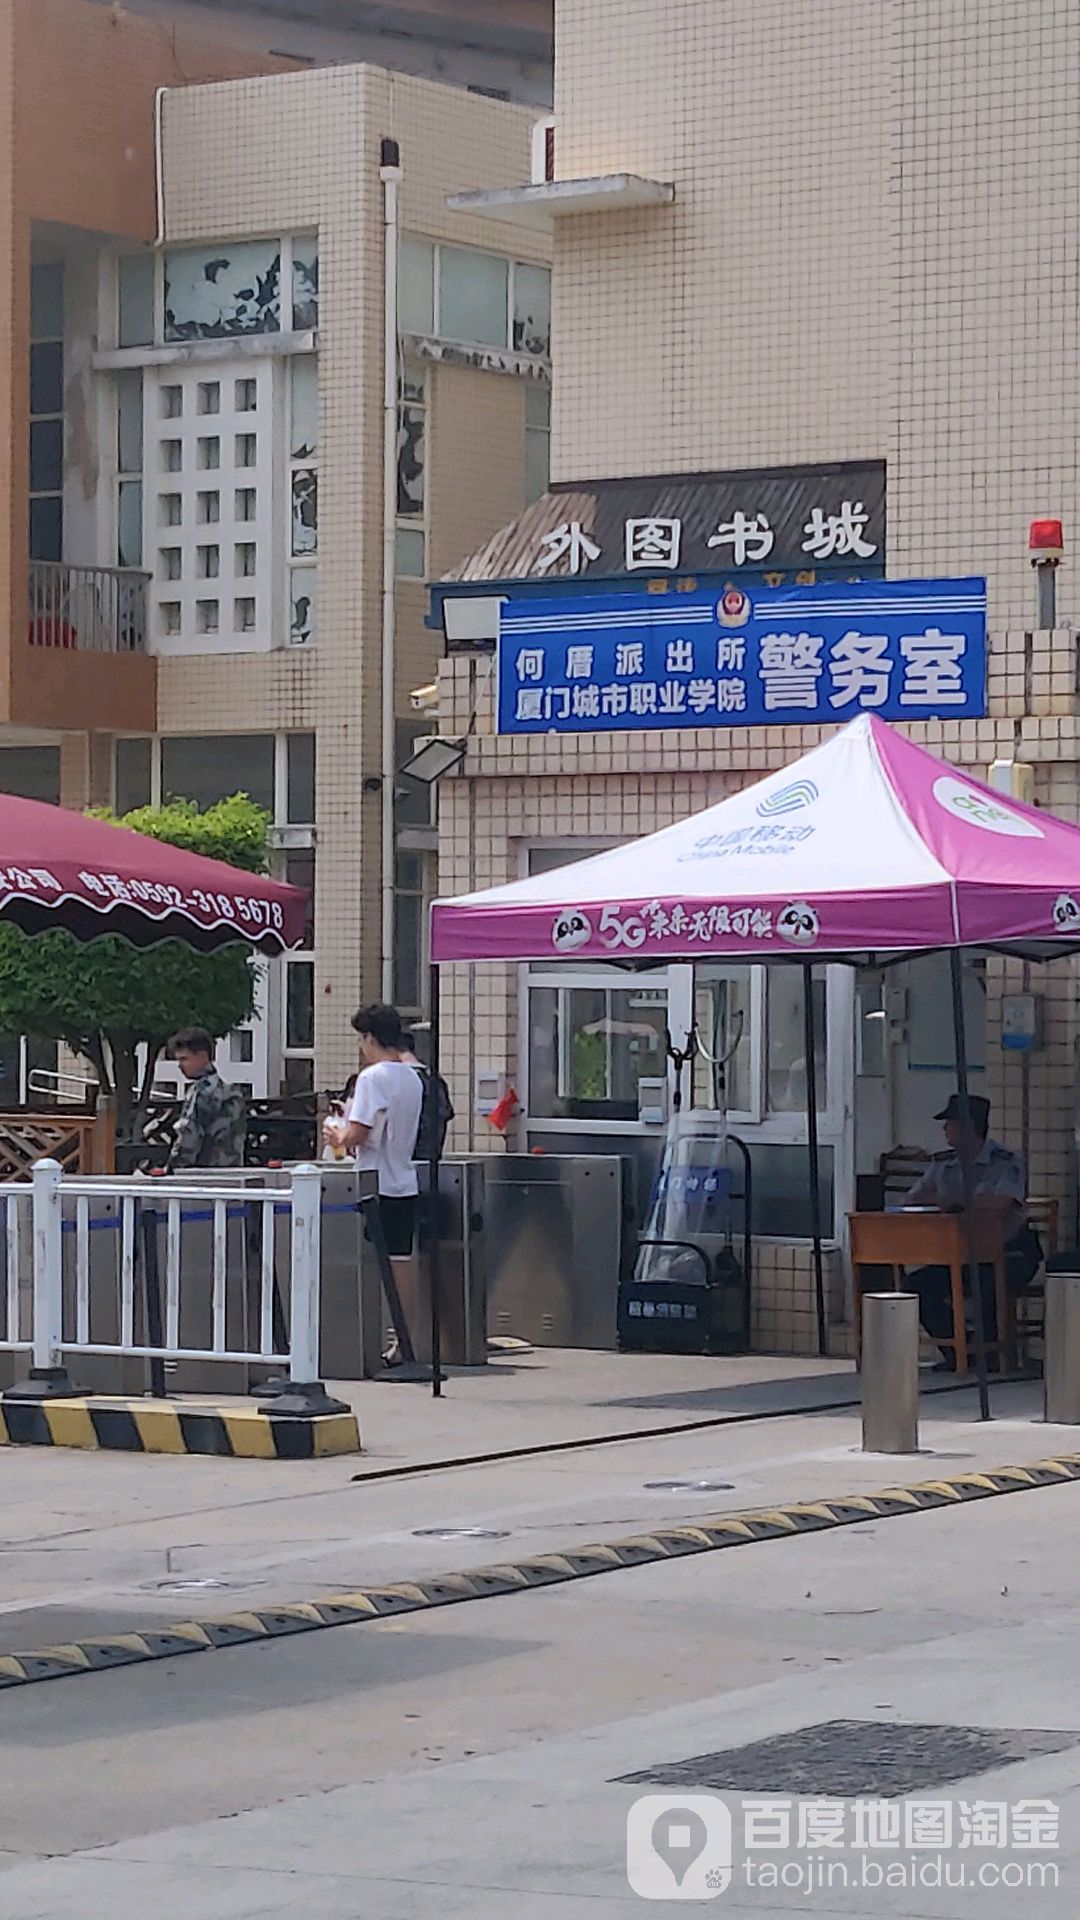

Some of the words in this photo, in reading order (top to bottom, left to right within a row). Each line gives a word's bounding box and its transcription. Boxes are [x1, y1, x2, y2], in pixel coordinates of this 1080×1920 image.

[534, 501, 877, 574] 外图书城
[515, 637, 746, 681] 何厝派出所
[758, 628, 967, 711] 警务室
[515, 677, 746, 720] 厦门城市职业学院
[694, 824, 816, 848] 中国移动
